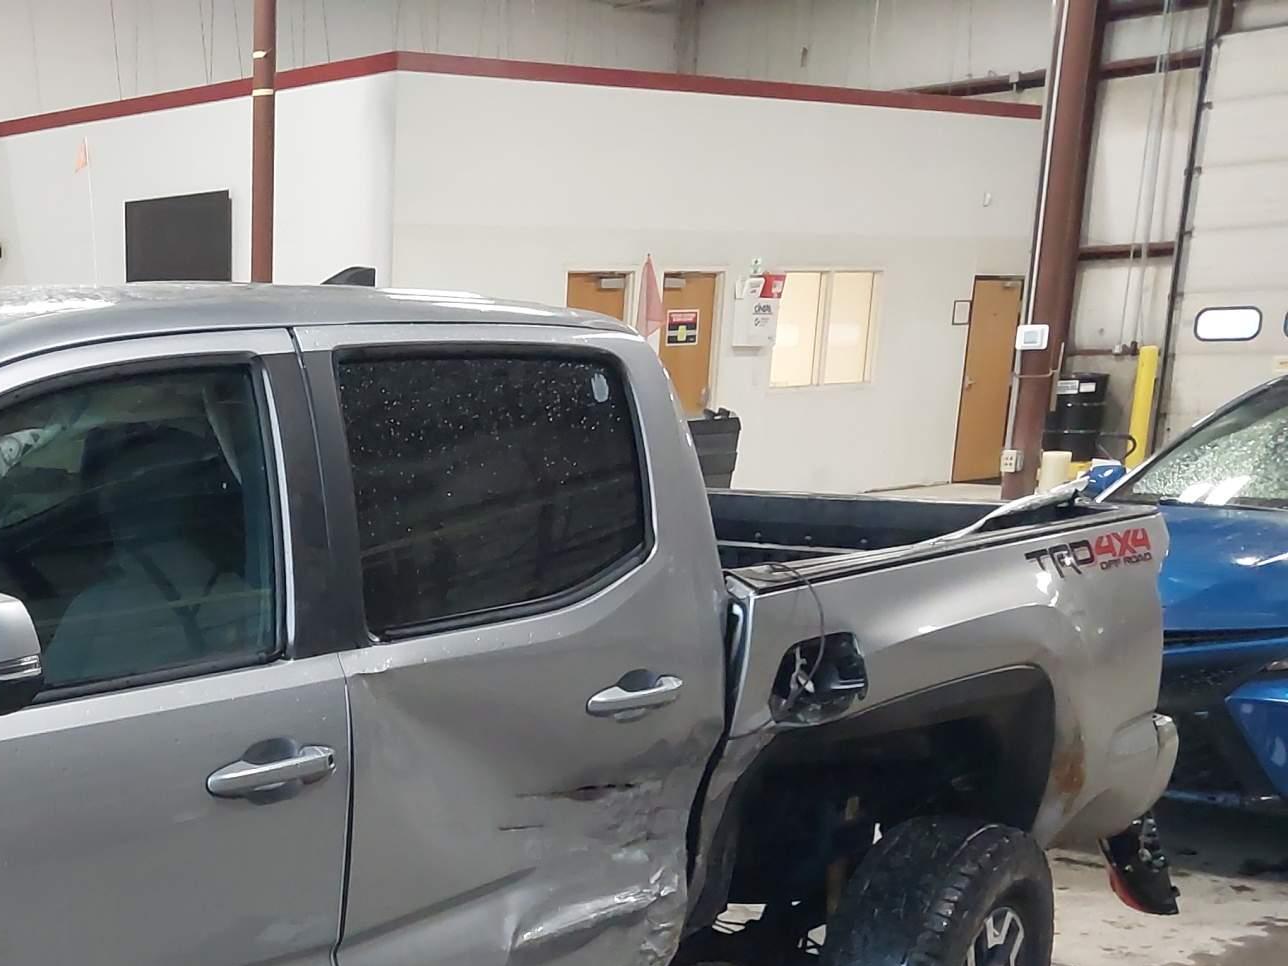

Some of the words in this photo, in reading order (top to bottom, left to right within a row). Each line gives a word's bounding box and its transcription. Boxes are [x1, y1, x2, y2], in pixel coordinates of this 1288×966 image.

[1024, 540, 1095, 578] TRD
[1100, 558, 1121, 570] OFF
[1123, 552, 1153, 564] ROAD
